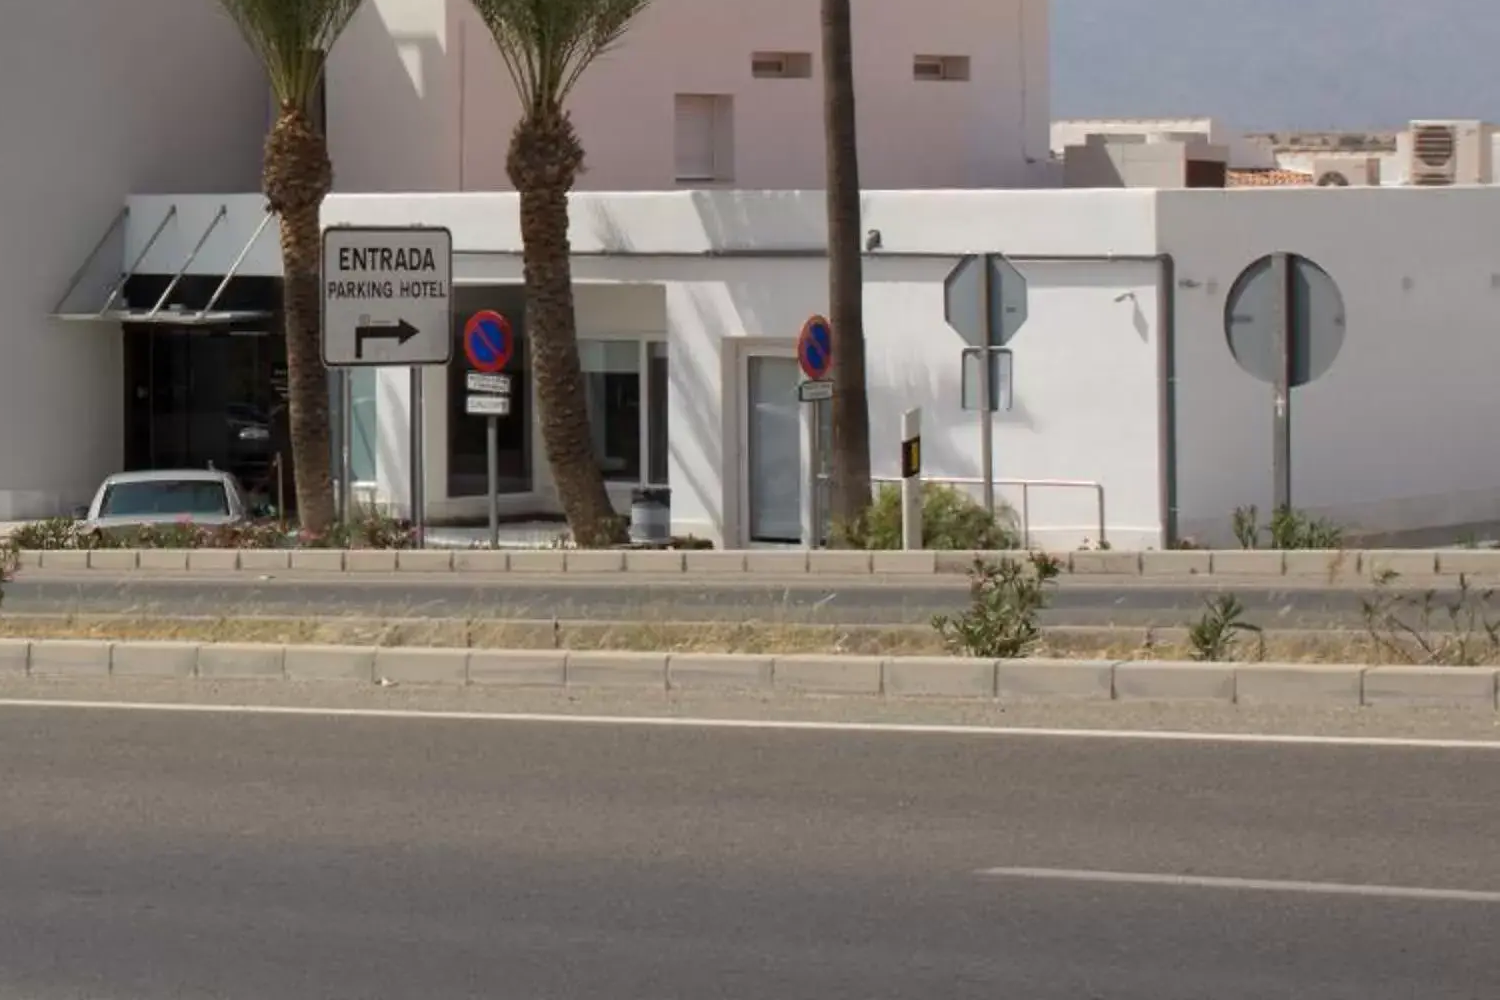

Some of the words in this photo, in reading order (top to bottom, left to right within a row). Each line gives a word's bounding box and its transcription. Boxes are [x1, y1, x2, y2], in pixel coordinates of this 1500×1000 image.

[339, 248, 436, 271] ENTRADA
[328, 281, 393, 298] PARKING
[400, 281, 447, 298] HOTEL
